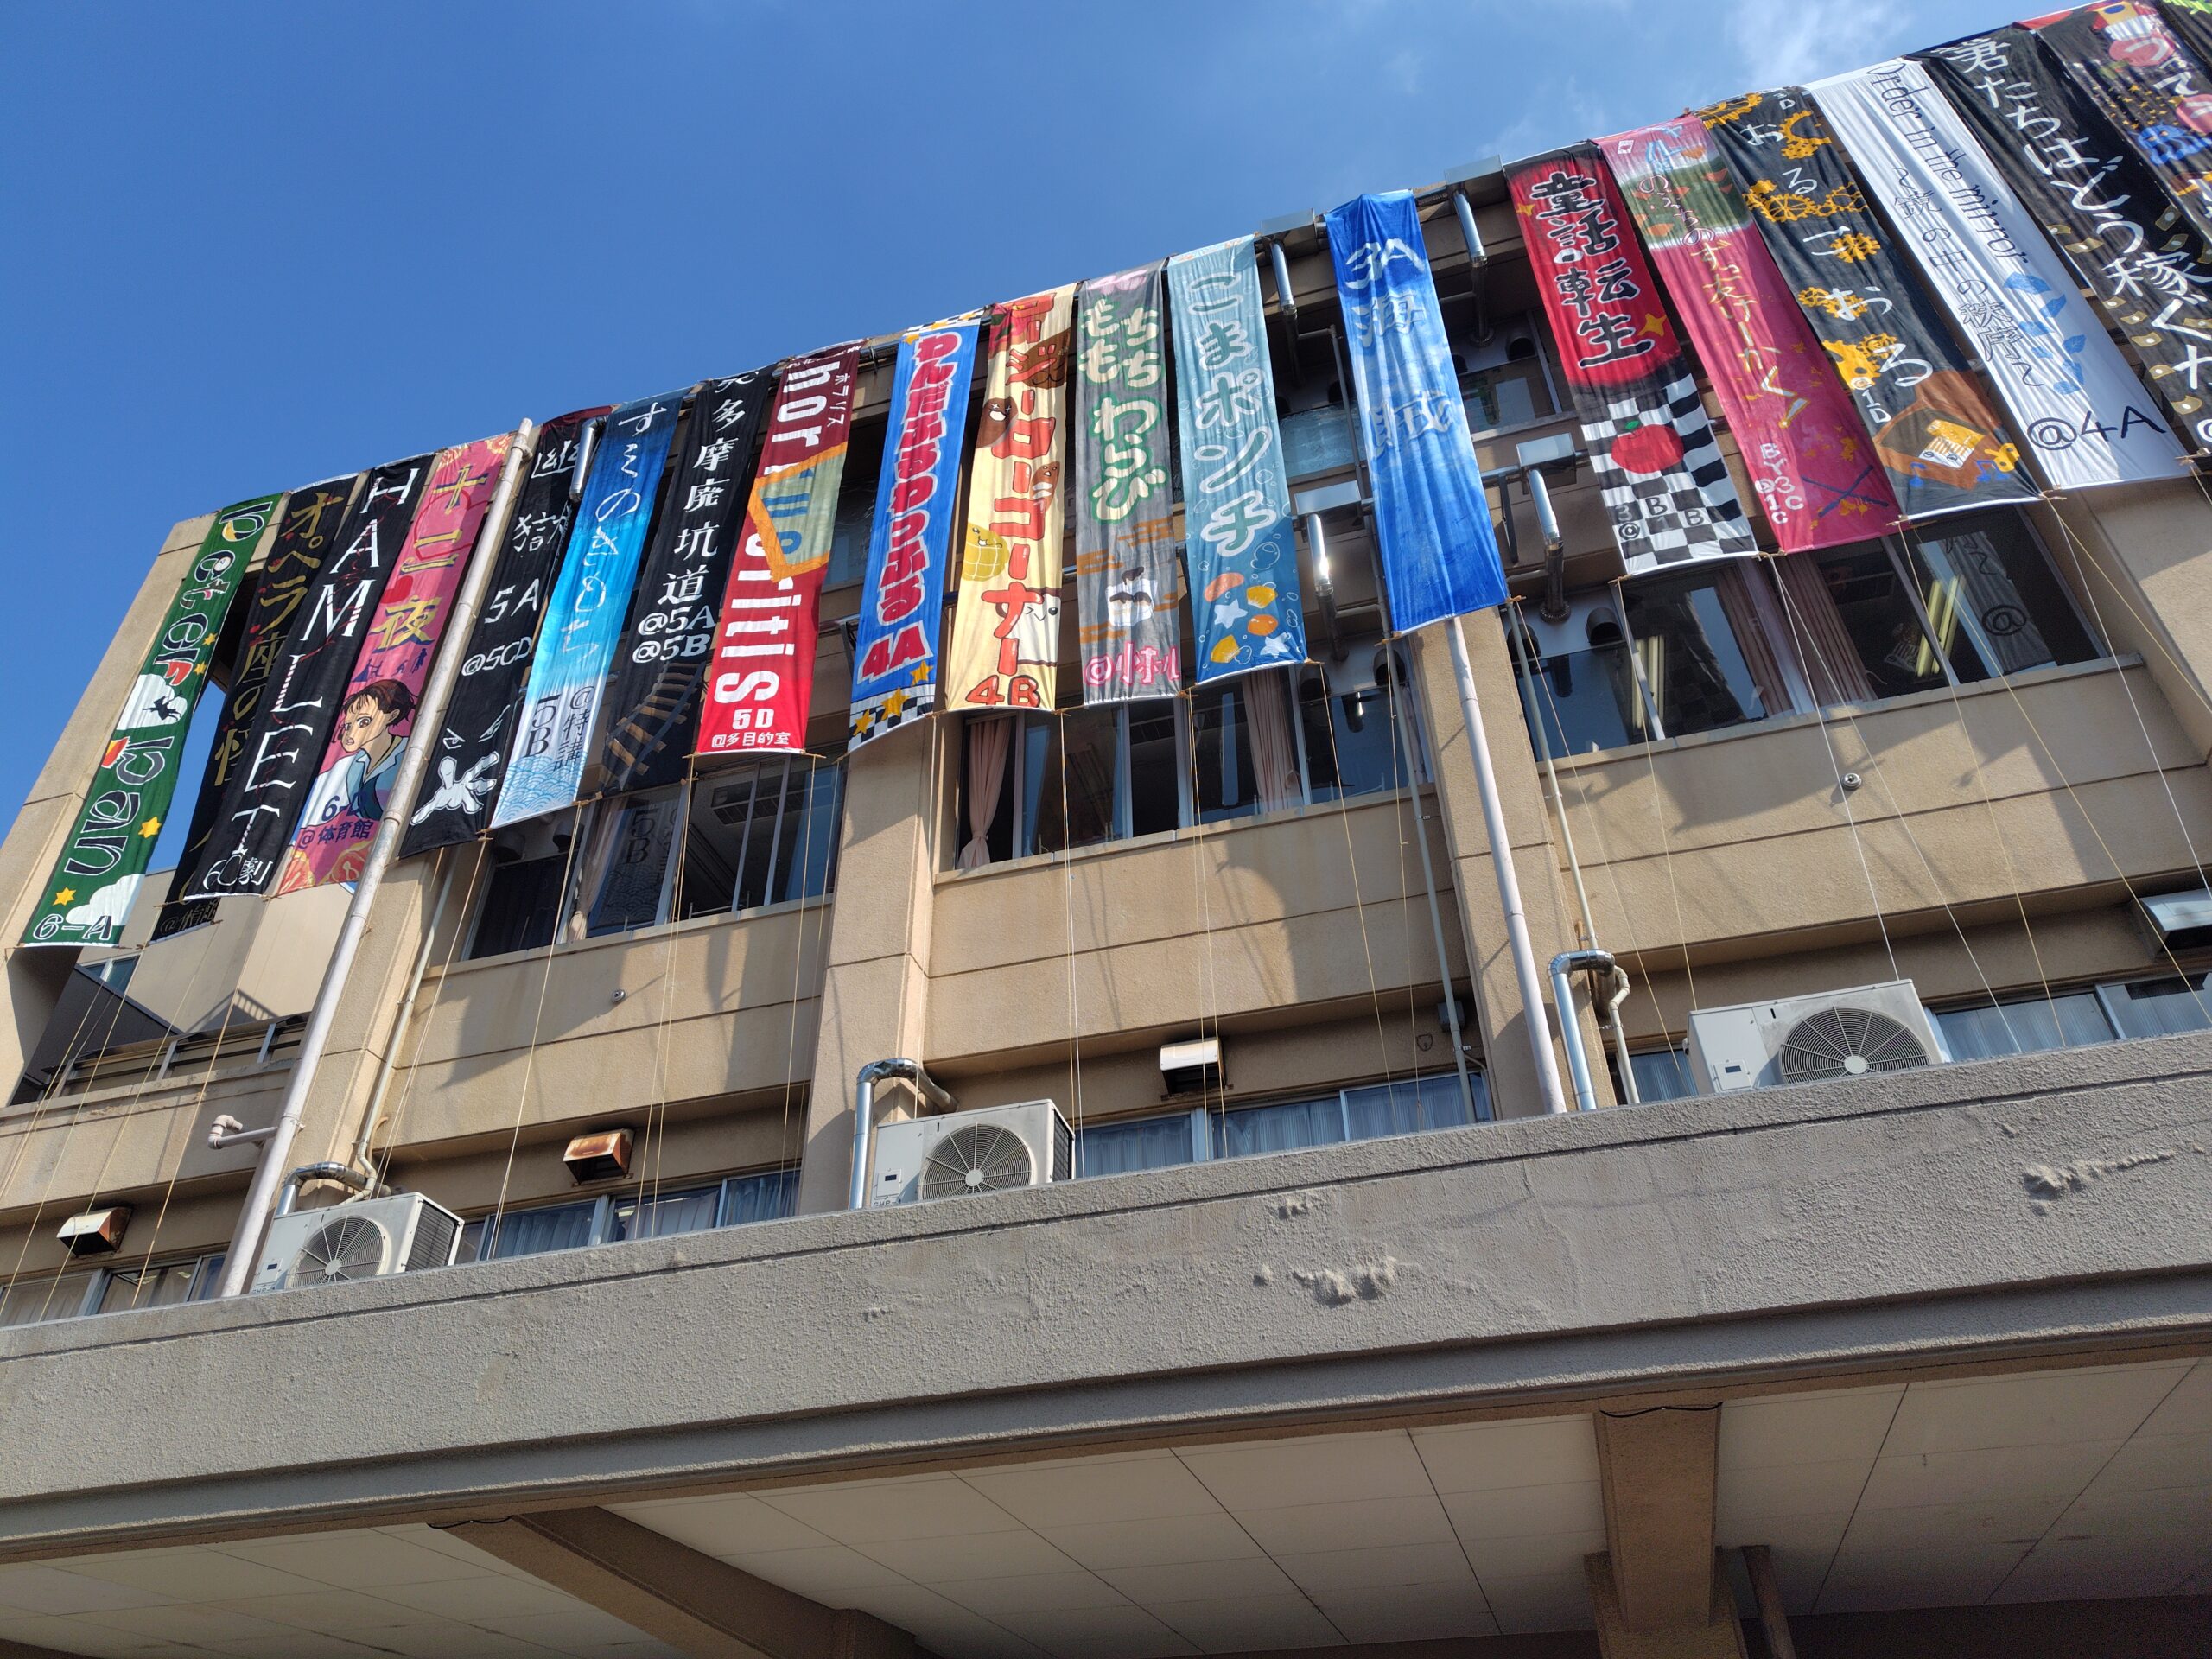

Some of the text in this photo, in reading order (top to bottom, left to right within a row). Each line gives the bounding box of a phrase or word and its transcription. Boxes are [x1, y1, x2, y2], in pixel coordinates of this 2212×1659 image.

[1866, 62, 2029, 264] Order in the mirror
[1529, 171, 1655, 368] 童話転生
[826, 372, 851, 428] ホラリス
[2027, 404, 2167, 451] @4A
[368, 463, 489, 653] 十二夜
[484, 578, 540, 624] 5A
[638, 605, 716, 636] @5A
[231, 467, 420, 855] HAMLET
[461, 636, 533, 677] @5CD
[632, 633, 710, 664] @5B
[857, 621, 929, 684] 4A
[965, 674, 1041, 709] 4B
[523, 694, 562, 758] 5B
[553, 685, 595, 772] @特講
[711, 731, 791, 748] @多目的室
[732, 708, 775, 730] 5D
[299, 818, 374, 849] @体育館
